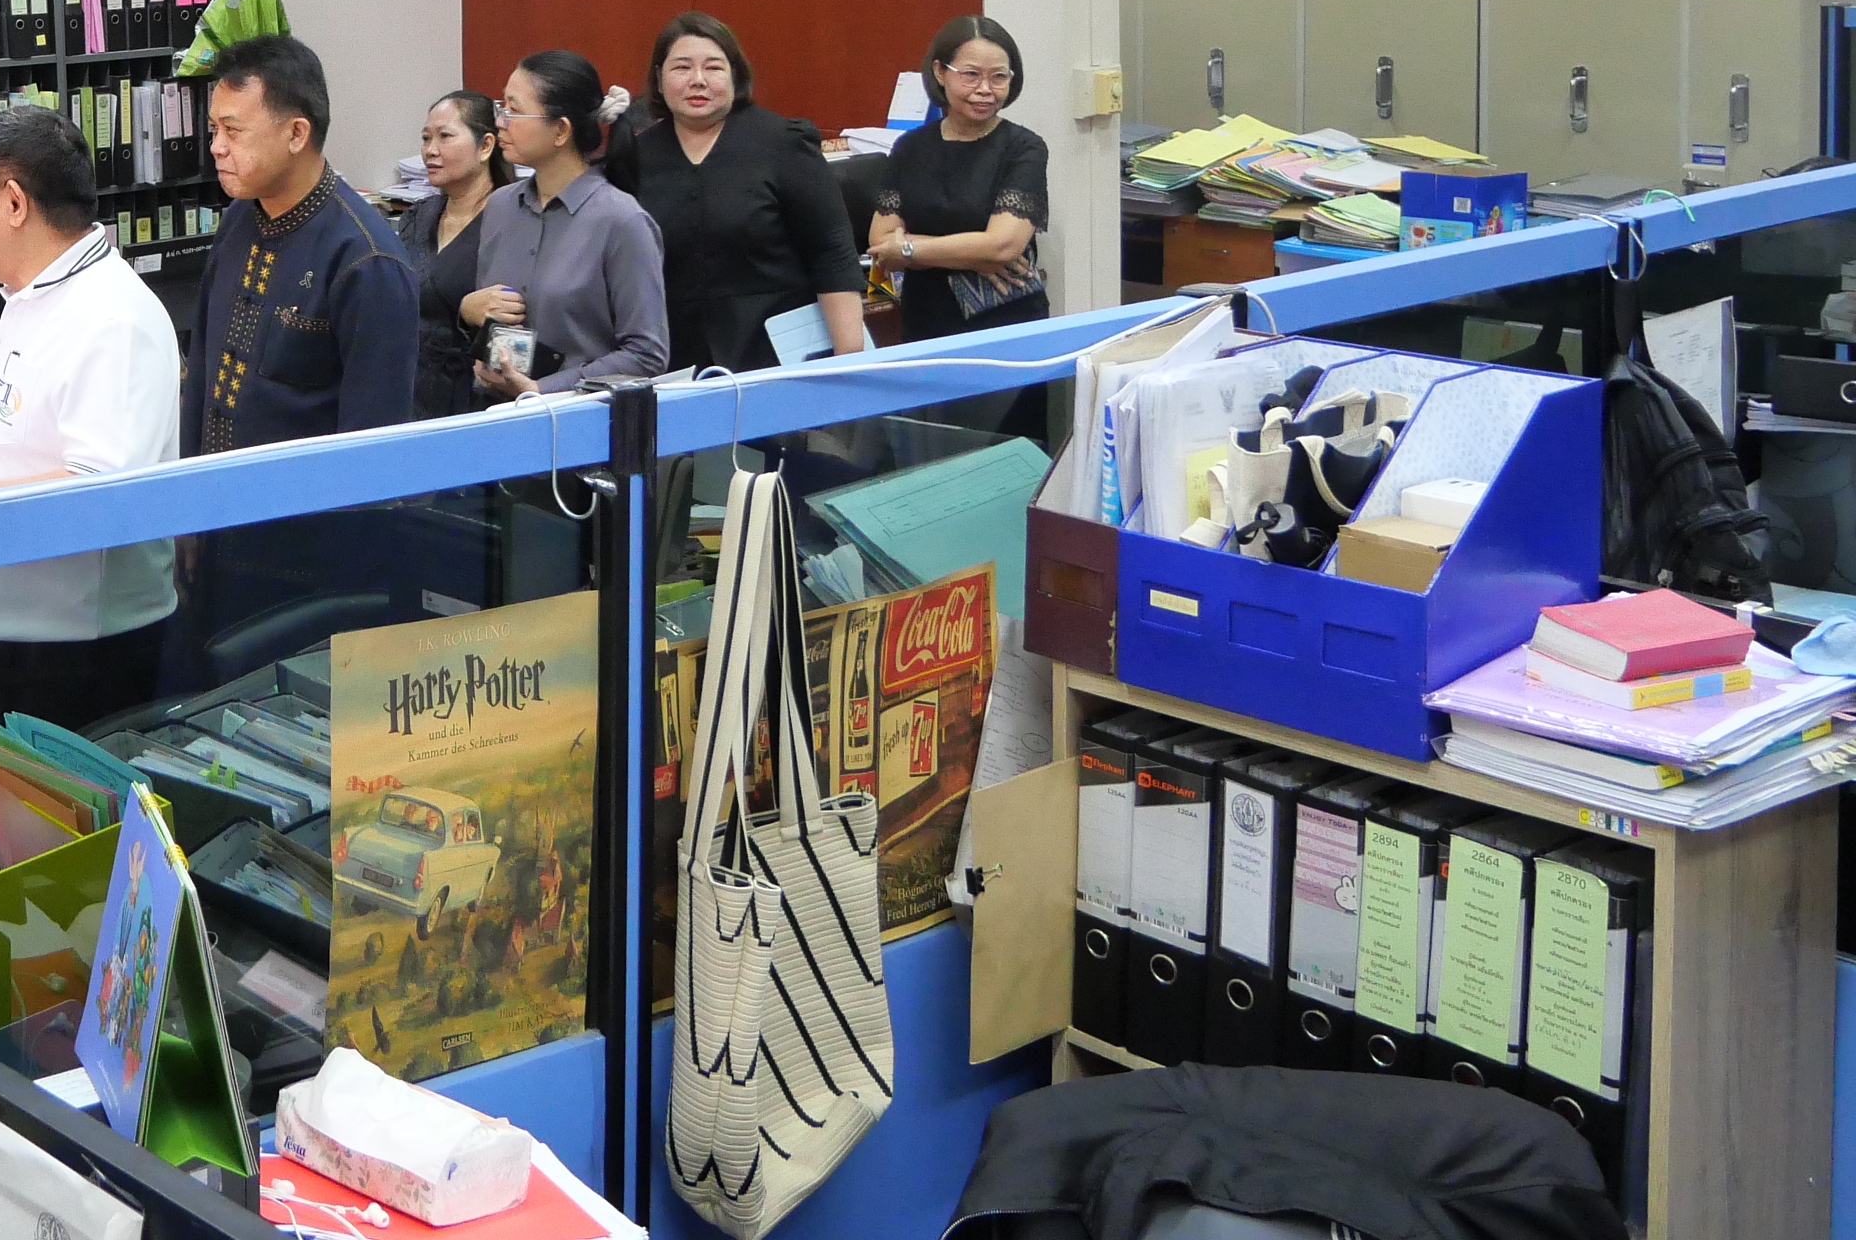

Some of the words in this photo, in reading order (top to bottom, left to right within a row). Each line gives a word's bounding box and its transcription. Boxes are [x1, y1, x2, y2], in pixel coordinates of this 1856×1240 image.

[443, 622, 511, 647] ROWLING
[896, 585, 978, 673] Coca-Cola
[383, 665, 462, 736] Harry
[464, 654, 546, 733] Potter
[428, 725, 447, 741] und
[449, 723, 464, 737] die
[408, 745, 449, 762] Kammer
[451, 741, 467, 755] des
[469, 732, 520, 751] Schreckens
[1151, 778, 1197, 800] ELEPHANT
[1372, 832, 1399, 850] 2894
[1367, 850, 1404, 868] คดีปกครอง
[1471, 849, 1500, 868] 2864
[1463, 867, 1506, 889] คดีปกครอง
[1557, 871, 1587, 891] 2870
[886, 906, 907, 922] Fred
[909, 898, 937, 916] Herzog
[1550, 889, 1593, 911] คดีปกครอง
[443, 1033, 472, 1049] CARLSEN
[284, 1134, 307, 1158] festa
